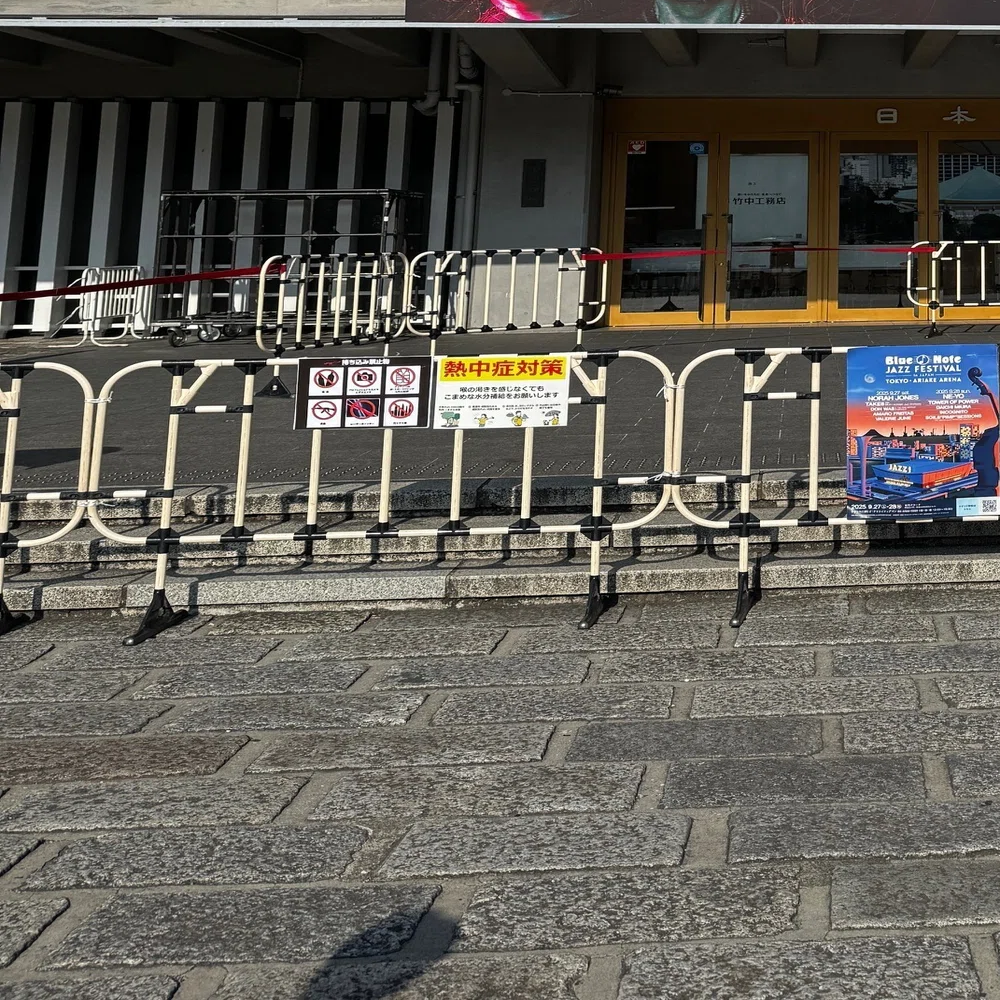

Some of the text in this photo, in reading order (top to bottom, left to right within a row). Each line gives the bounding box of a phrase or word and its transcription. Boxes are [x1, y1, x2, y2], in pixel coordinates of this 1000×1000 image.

[732, 196, 787, 205] 竹中工務店
[885, 354, 962, 365] Blue Note
[443, 359, 564, 378] 熱中症対策
[885, 364, 962, 374] JAZZ FESTIVAL
